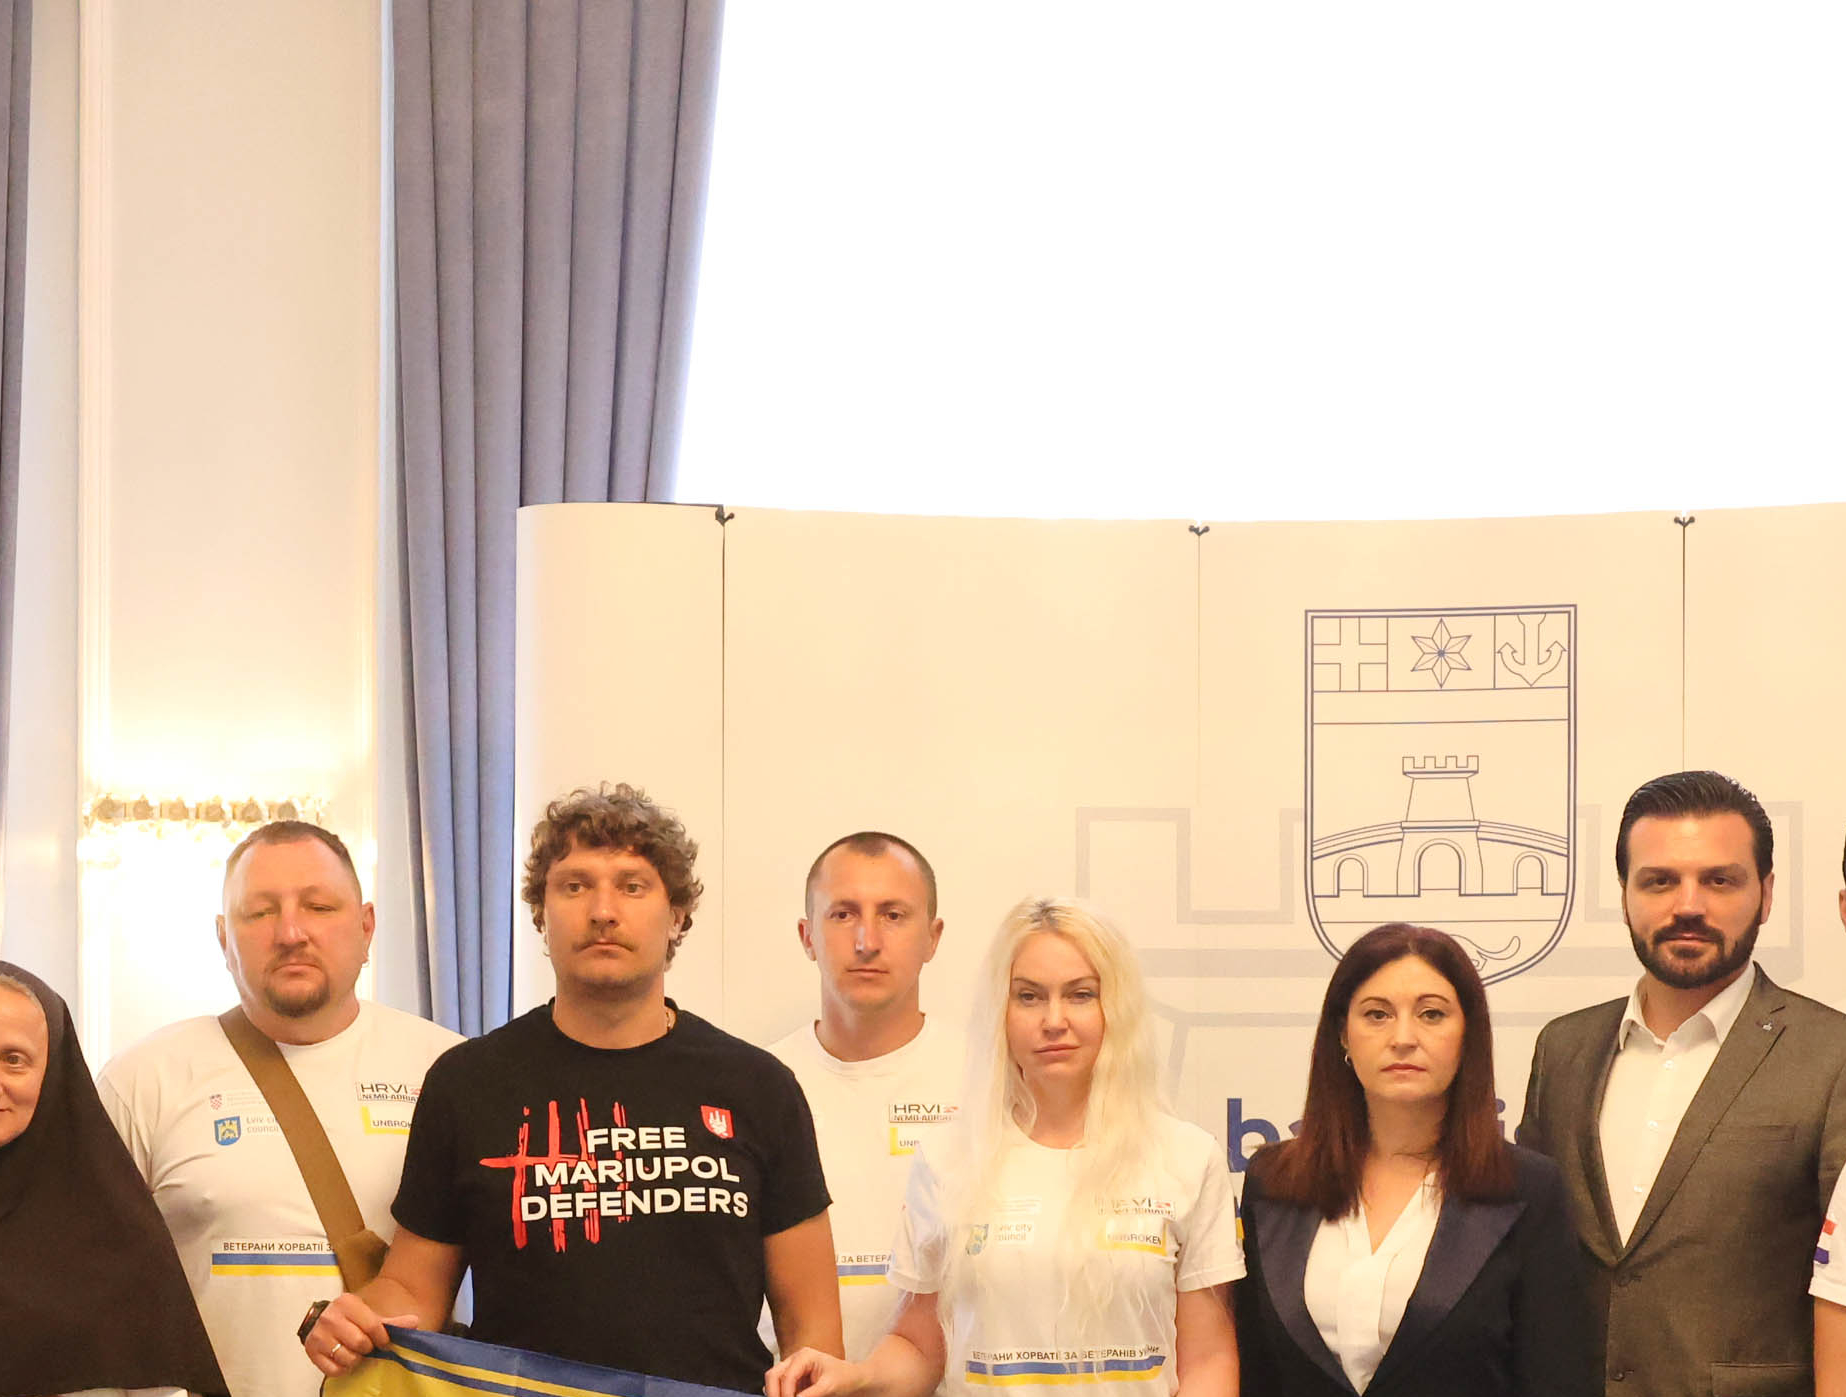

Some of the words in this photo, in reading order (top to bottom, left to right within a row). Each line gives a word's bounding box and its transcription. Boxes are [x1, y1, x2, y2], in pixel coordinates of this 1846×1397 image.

[361, 1083, 408, 1094] HRVI
[894, 1104, 941, 1114] HRVI
[371, 1119, 412, 1128] UNBROK
[586, 1126, 687, 1154] FREE
[534, 1156, 741, 1187] MARIUPOL
[520, 1187, 749, 1222] DEFENDERS
[223, 1242, 275, 1252] ВЕТЕРАНИ
[277, 1242, 324, 1252] ХОРВАТІЇ
[856, 1254, 892, 1263] ВЕТЕРА
[1016, 1351, 1060, 1361] ХОРВАТІ
[1064, 1351, 1078, 1360] ЗА
